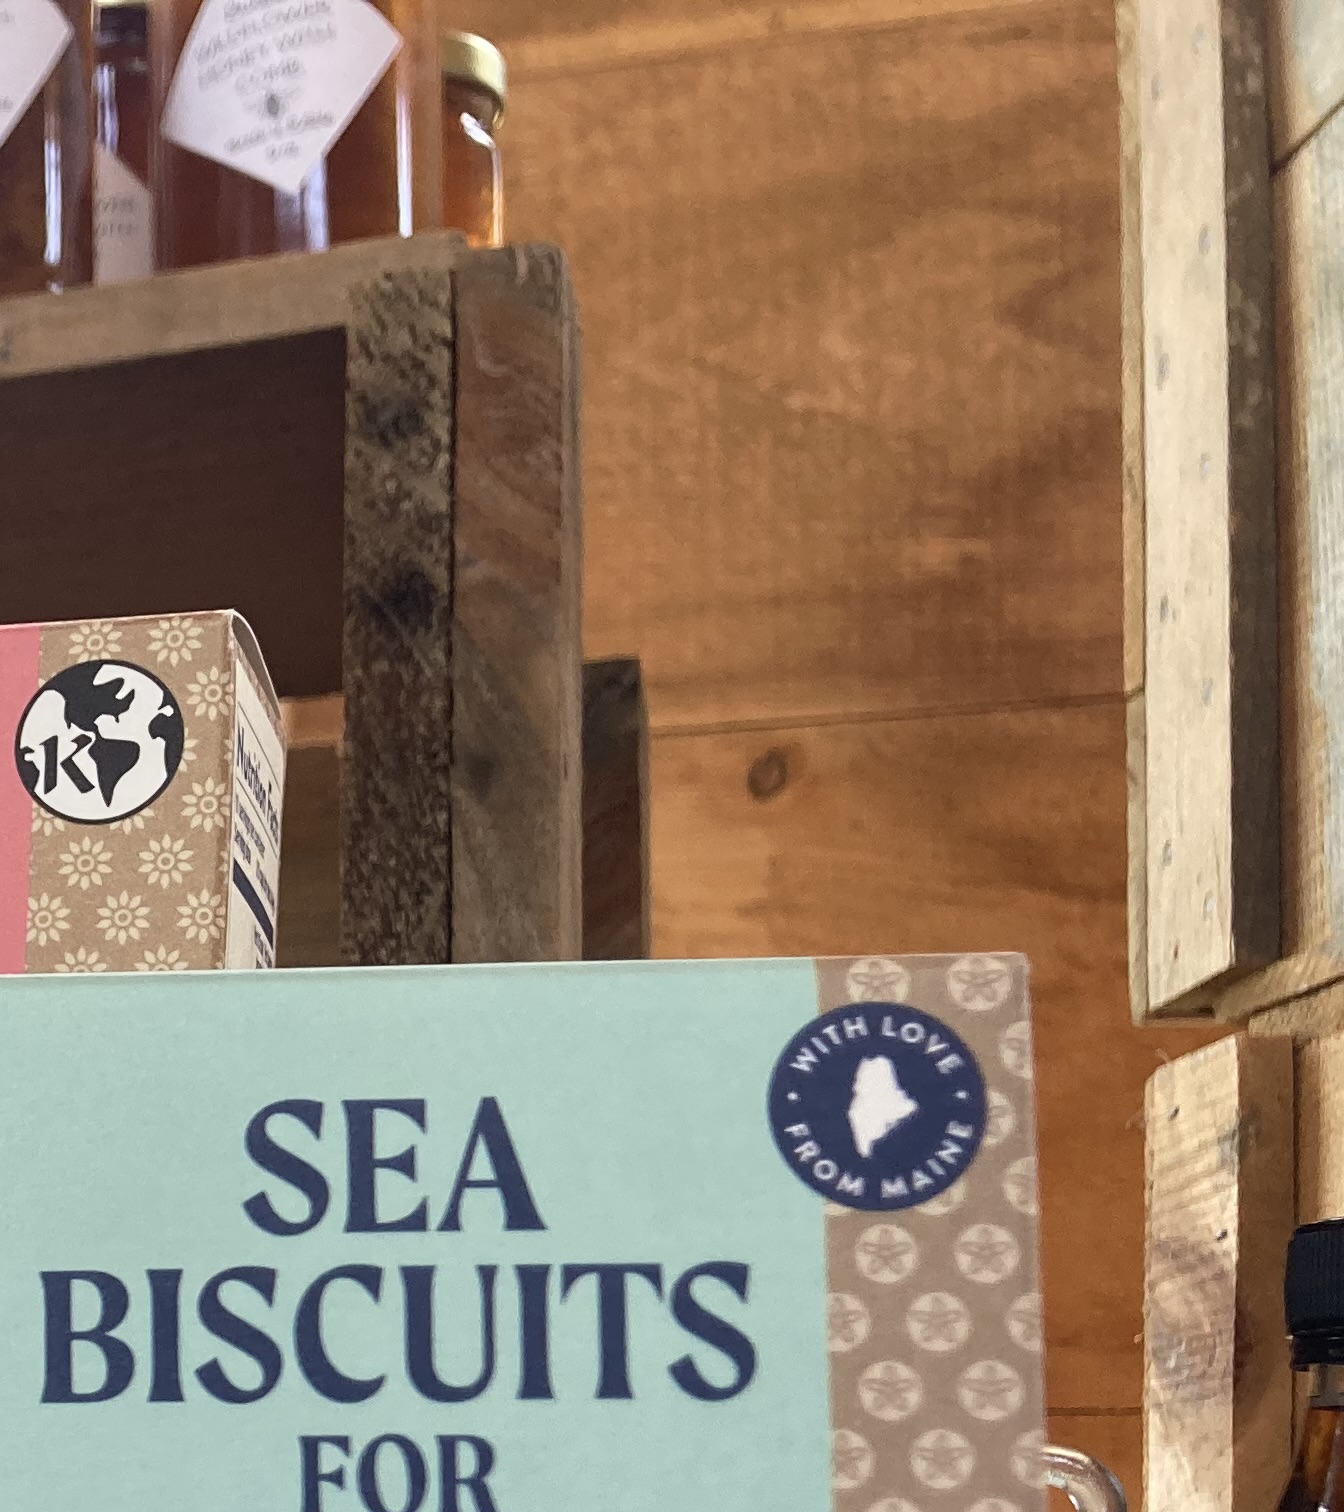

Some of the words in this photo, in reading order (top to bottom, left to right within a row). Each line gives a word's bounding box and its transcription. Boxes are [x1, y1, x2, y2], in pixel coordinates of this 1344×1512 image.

[788, 1015, 869, 1073] WITH
[880, 1015, 965, 1075] LOVE
[240, 1095, 549, 1238] SEA
[783, 1122, 867, 1197] FROM
[880, 1119, 974, 1199] MAINE
[38, 1260, 758, 1405] BISCUITS
